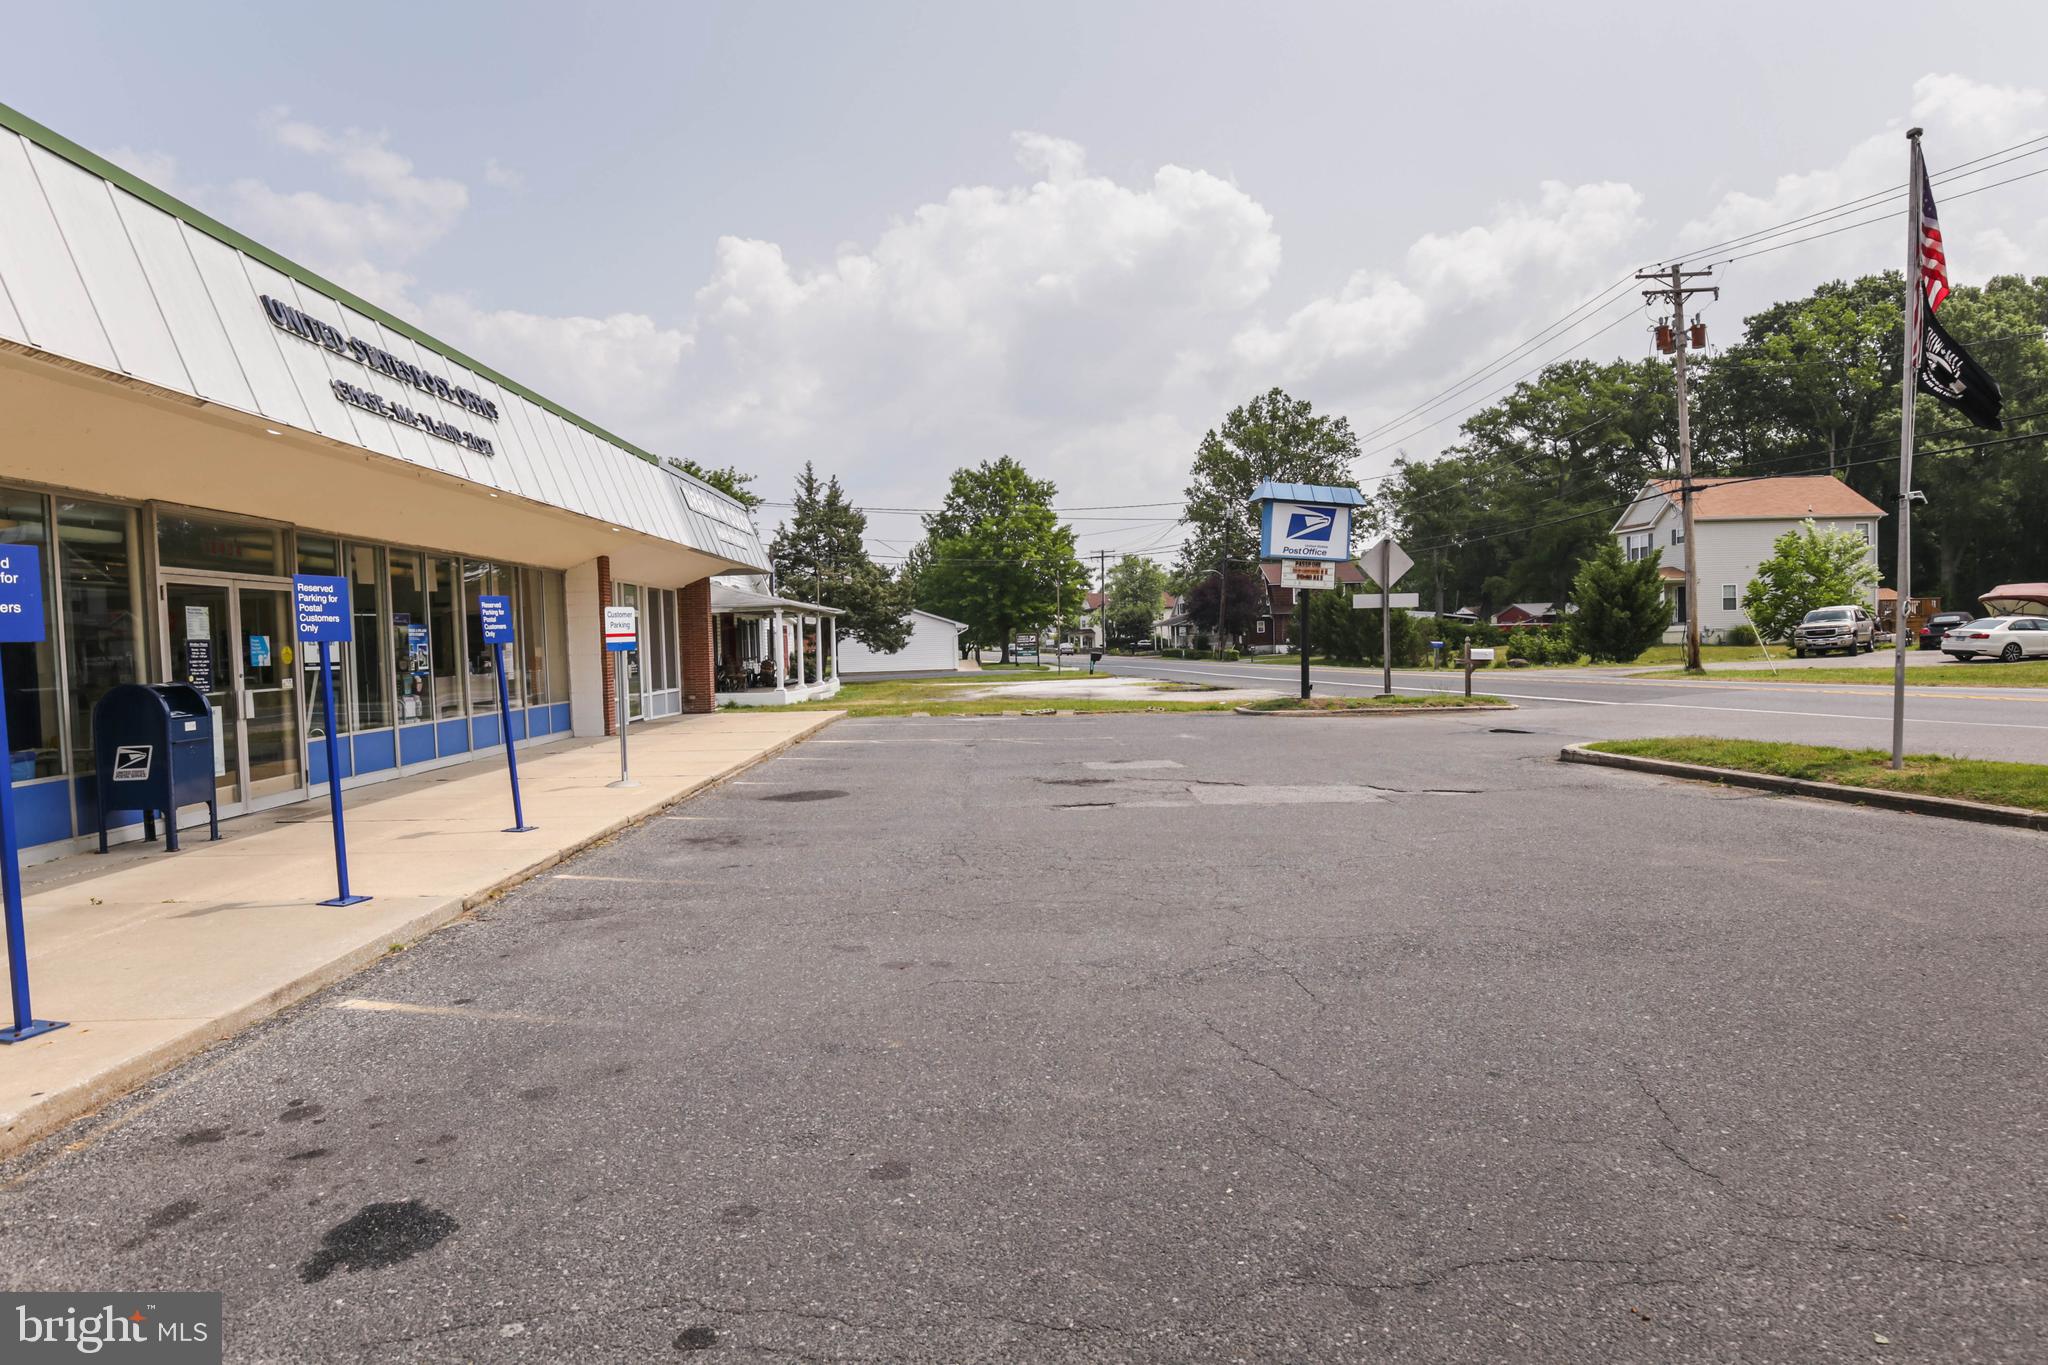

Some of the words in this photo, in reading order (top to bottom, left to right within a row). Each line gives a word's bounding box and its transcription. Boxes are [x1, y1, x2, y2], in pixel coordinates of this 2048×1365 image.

[259, 294, 347, 353] UNITED
[349, 336, 413, 384] STATES
[409, 364, 454, 400] POST
[1282, 546, 1302, 555] Post
[1302, 547, 1327, 556] Office
[297, 583, 334, 593] Reserved
[298, 593, 327, 604] Parking
[328, 595, 338, 603] for
[299, 603, 323, 612] Postal
[300, 613, 340, 623] Customers
[300, 624, 319, 634] Only
[610, 622, 631, 630] Parking
